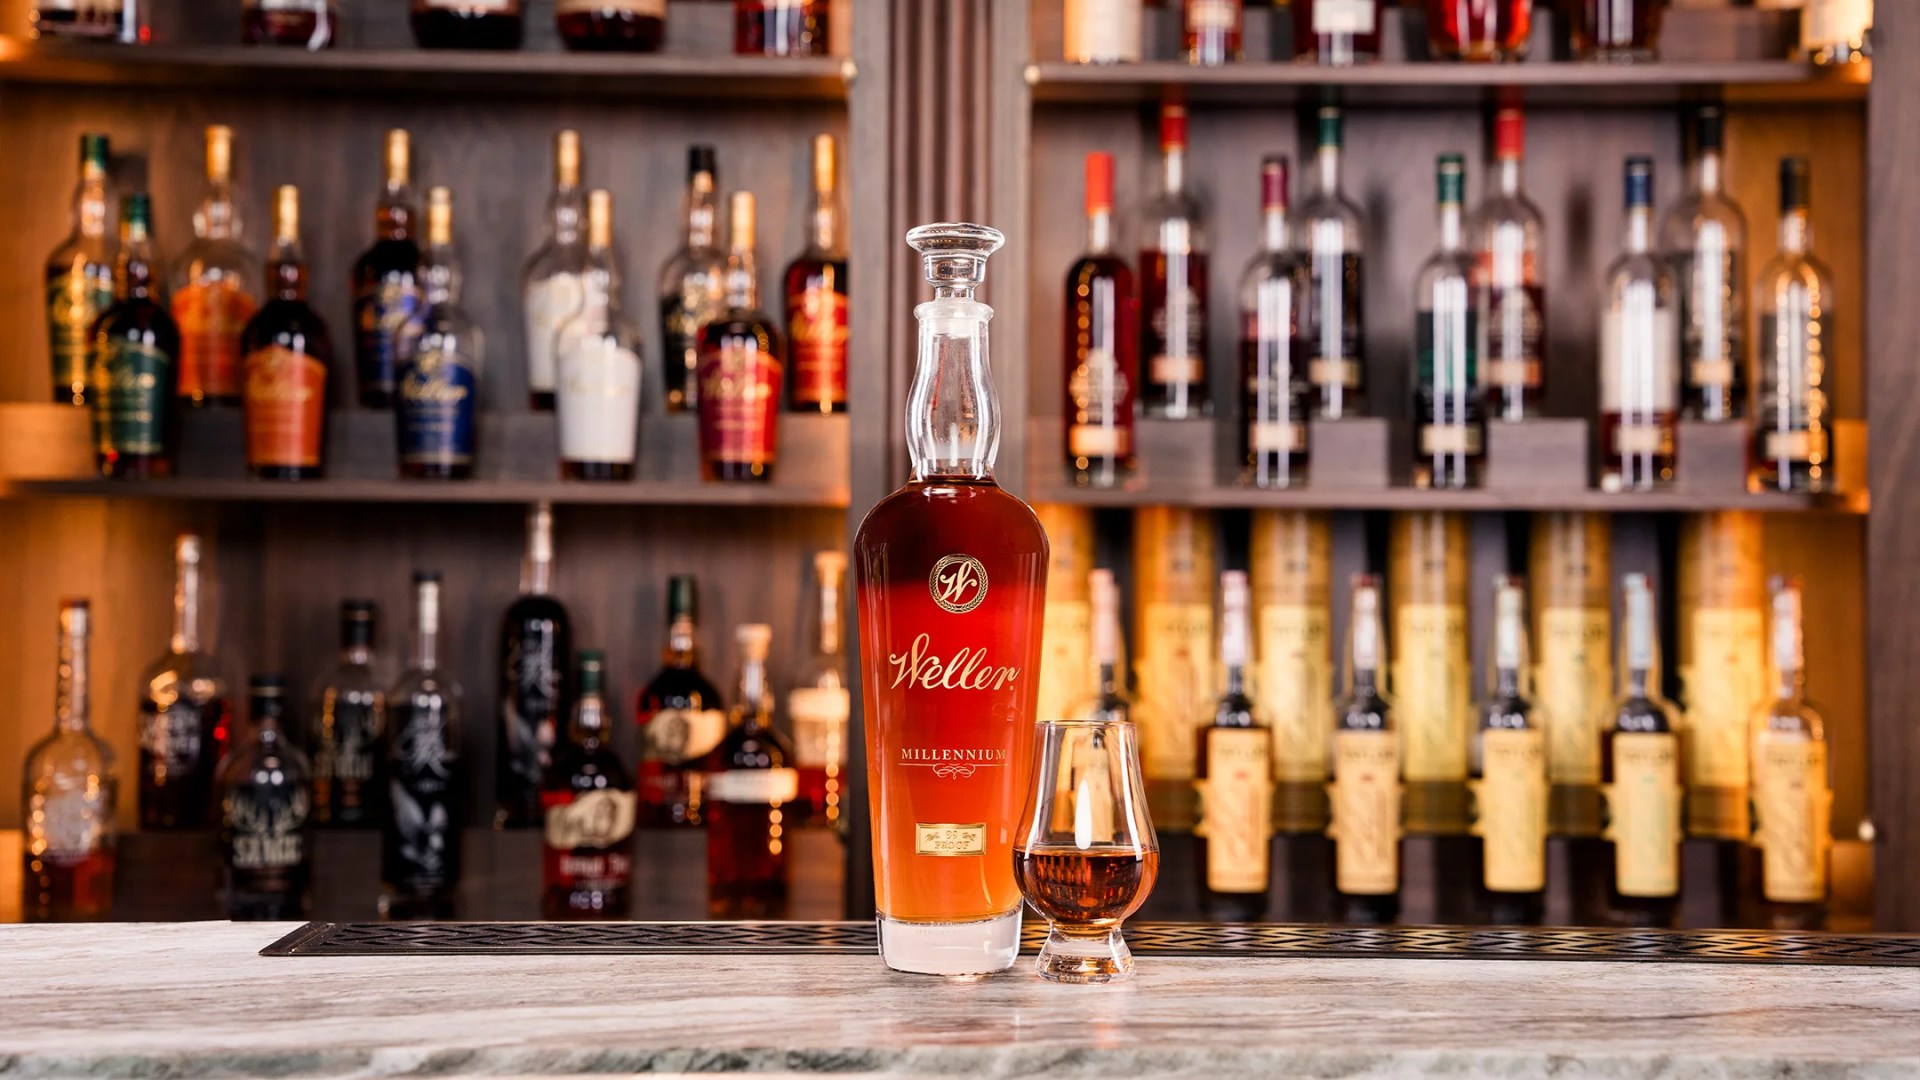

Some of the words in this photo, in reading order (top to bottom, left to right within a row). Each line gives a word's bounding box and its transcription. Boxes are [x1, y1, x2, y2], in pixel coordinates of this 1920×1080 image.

[939, 560, 977, 602] W
[901, 748, 1006, 761] MILLENNIUM
[945, 830, 958, 840] 99
[934, 840, 970, 850] PROOF
